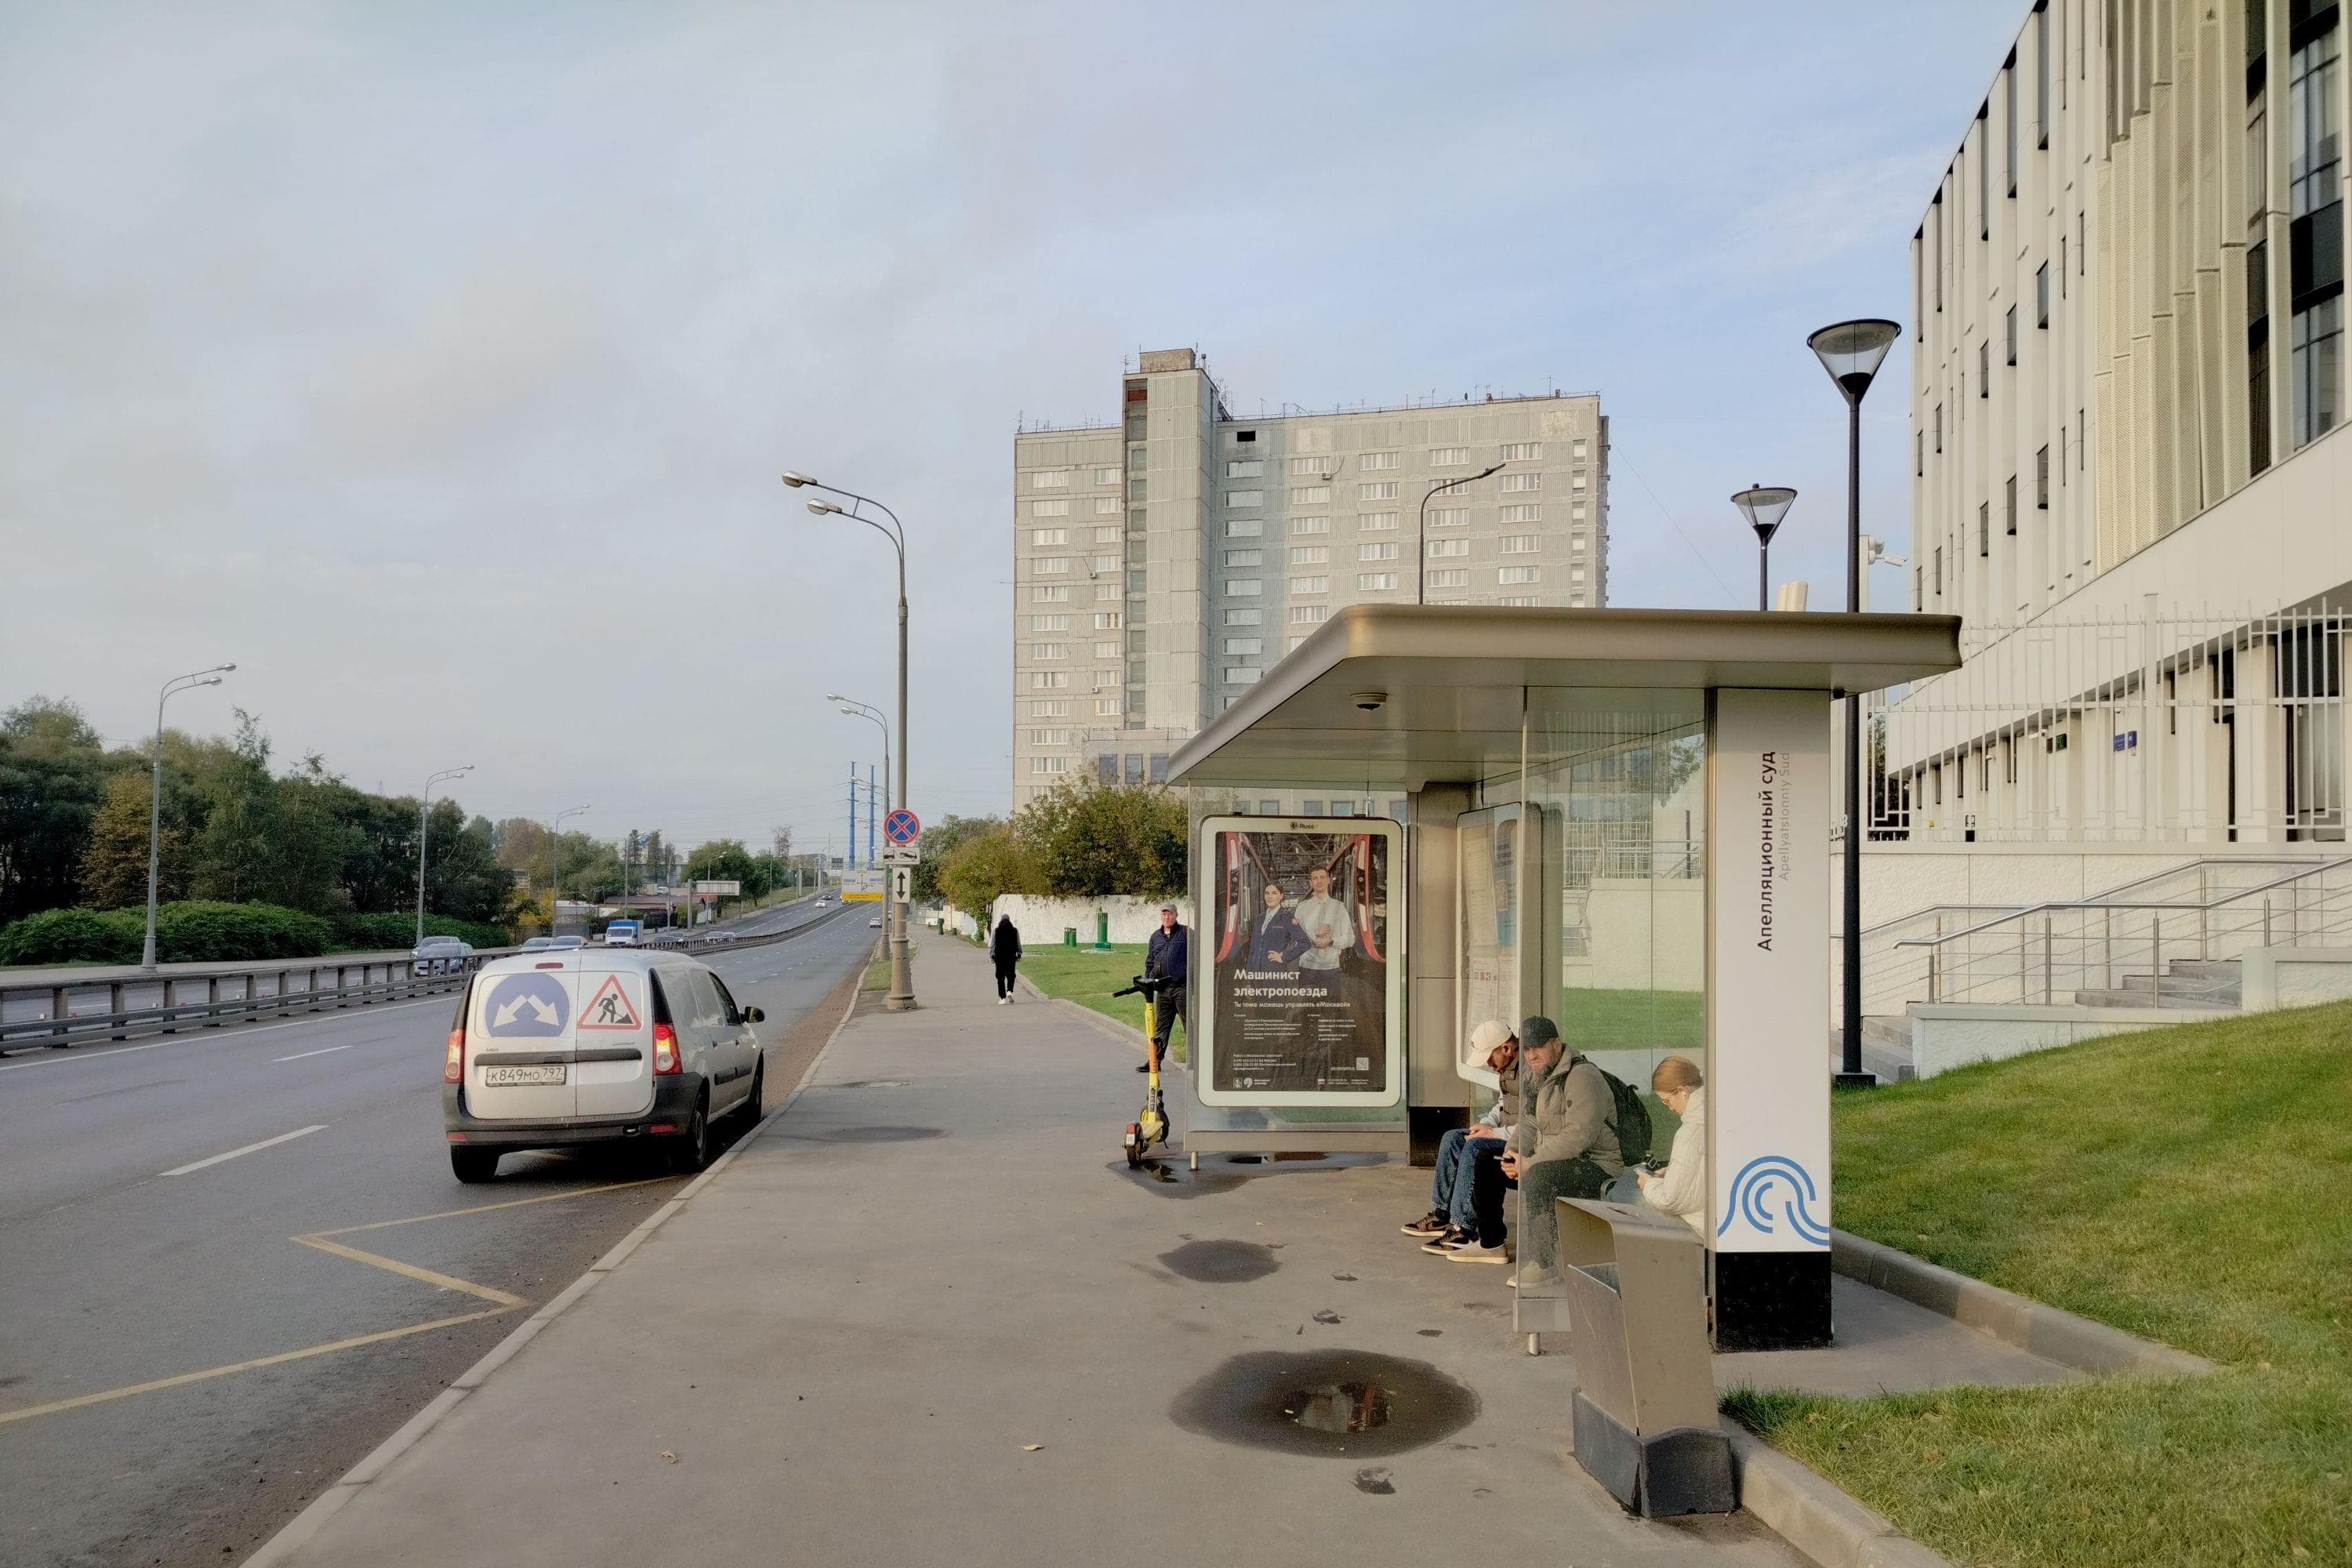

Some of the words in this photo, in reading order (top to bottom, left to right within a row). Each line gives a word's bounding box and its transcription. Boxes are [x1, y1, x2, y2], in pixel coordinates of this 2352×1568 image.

[1762, 751, 1777, 785] суд
[1779, 752, 1791, 776] Sud
[1779, 782, 1792, 881] Apellyatsionniy
[1758, 790, 1776, 951] Апелляционный
[1233, 968, 1301, 980] Машинист
[1233, 987, 1328, 999] электропоезда
[543, 1067, 561, 1077] 797
